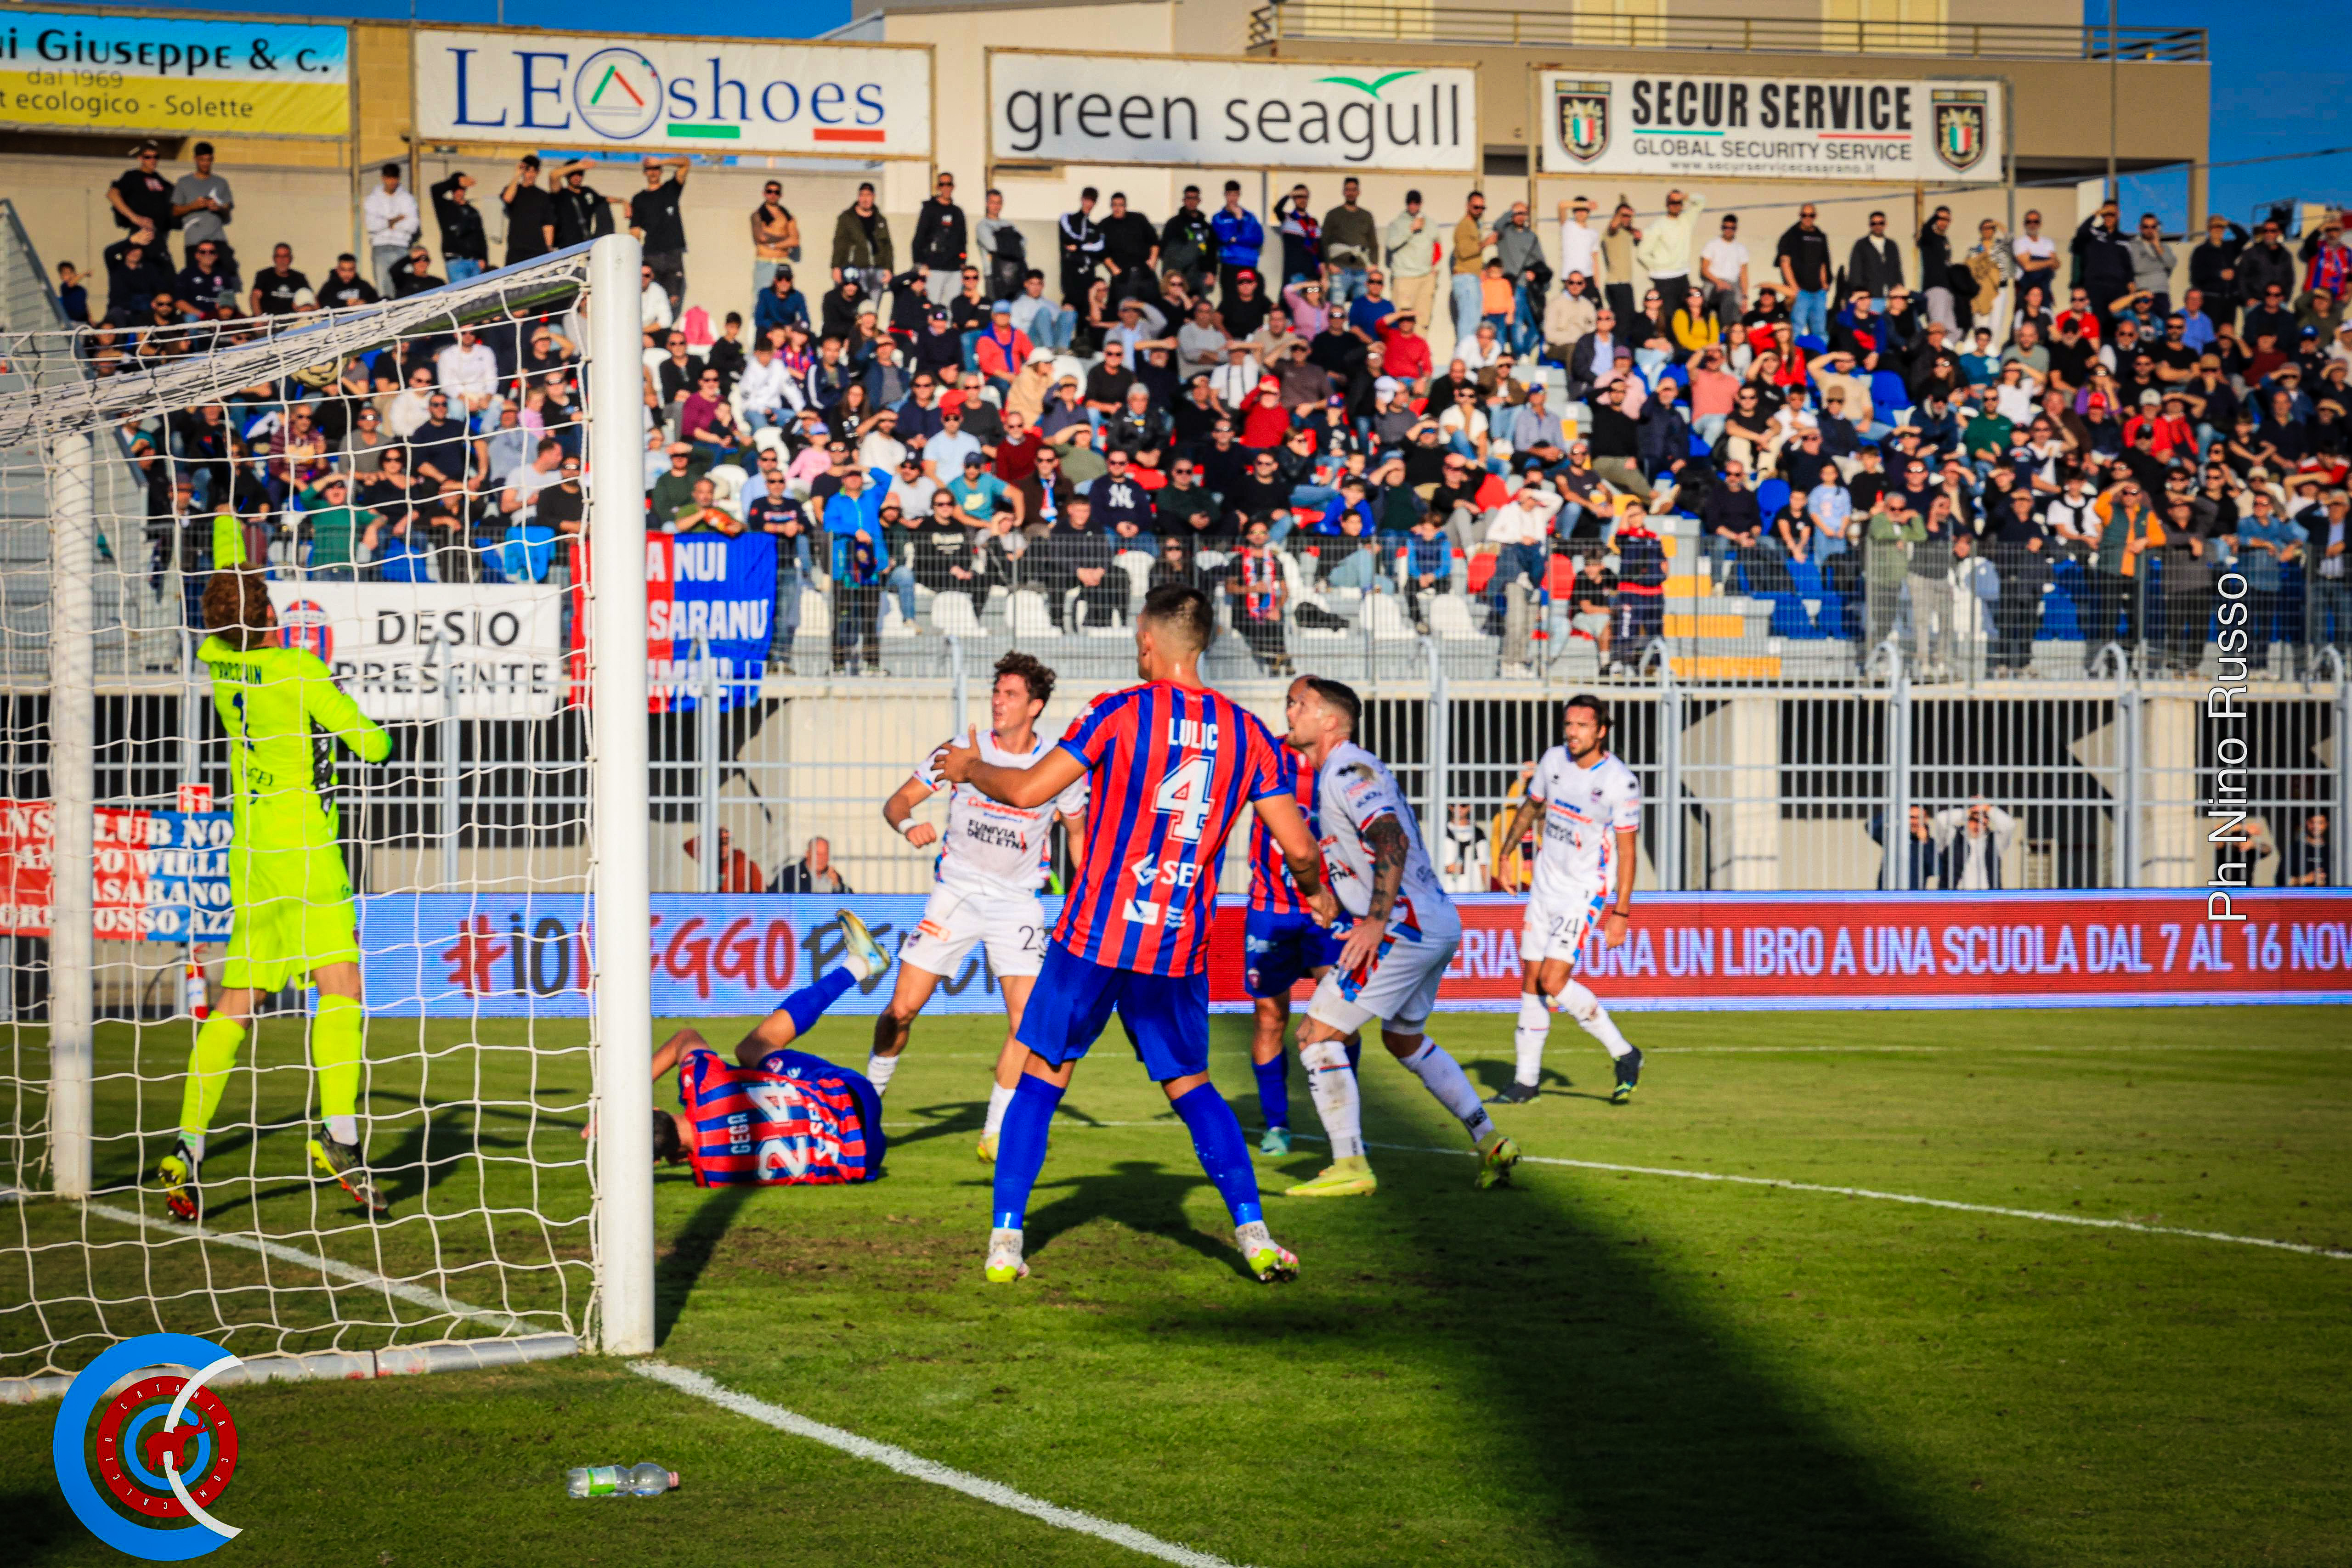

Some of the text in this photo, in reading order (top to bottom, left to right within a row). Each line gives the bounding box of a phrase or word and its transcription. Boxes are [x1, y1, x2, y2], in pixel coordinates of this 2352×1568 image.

[249, 38, 277, 71] &
[27, 68, 123, 89] dal 1969
[16, 91, 140, 118] ecologico
[165, 95, 253, 118] Solette
[1631, 79, 1912, 131] SECUR SERVICE
[1006, 83, 1459, 162] green seagull
[1633, 139, 1912, 161] GLOBAL SECURITY SERVICE
[674, 541, 727, 582] NUI
[377, 610, 520, 646] DESIO
[647, 598, 769, 641] SARANU
[1167, 717, 1219, 751] LULIC
[1149, 754, 1216, 845] 4
[93, 813, 172, 846] LUB
[93, 877, 230, 906] SARANO
[93, 909, 180, 935] OSSO
[1549, 915, 1578, 939] 24
[1664, 927, 1716, 976] UN
[1722, 926, 1825, 976] LIBRO
[1831, 925, 1859, 976] A
[1864, 925, 1936, 976] UNA
[1942, 924, 2081, 975] SCUOLA
[2086, 923, 2153, 973] DAL
[2159, 923, 2182, 973] 7
[2188, 923, 2233, 973] AL
[2242, 922, 2283, 971] 16
